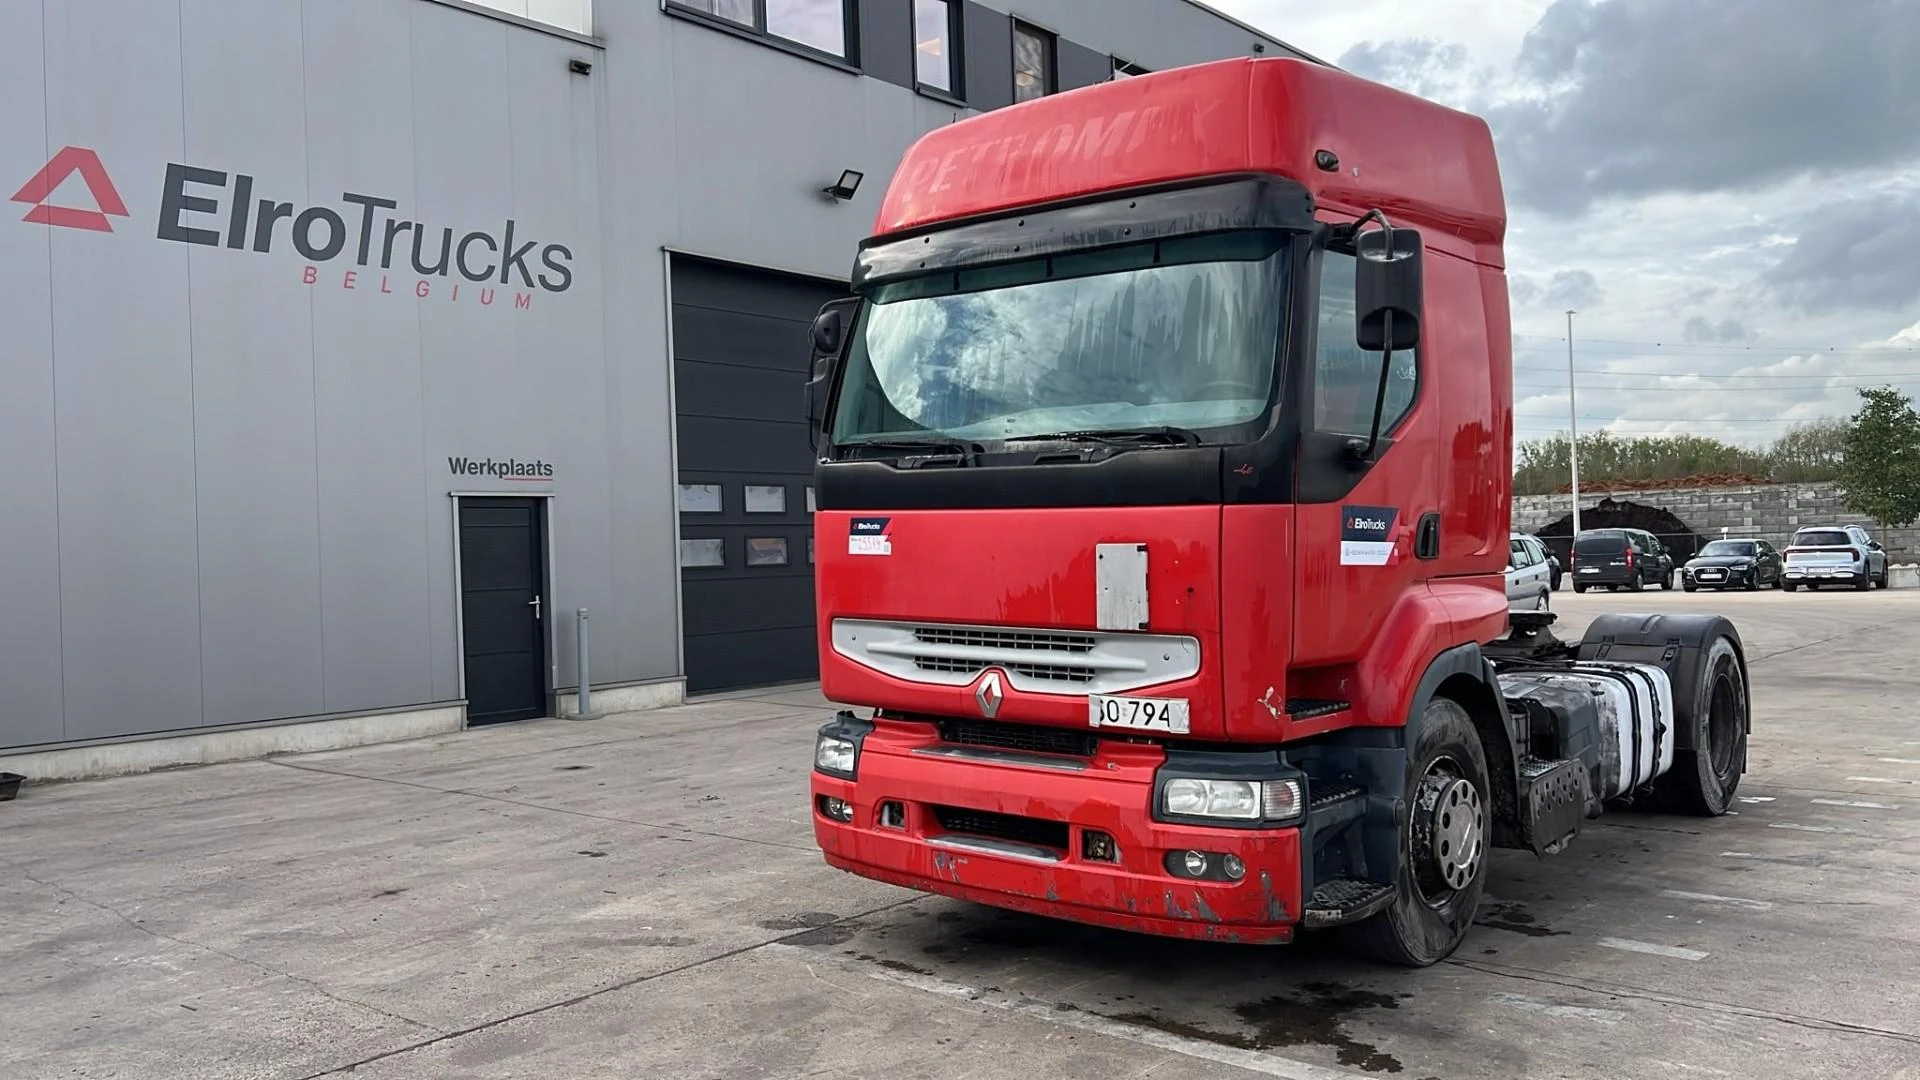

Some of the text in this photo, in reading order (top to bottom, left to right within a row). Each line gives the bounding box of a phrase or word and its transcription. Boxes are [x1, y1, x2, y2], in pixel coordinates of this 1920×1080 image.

[156, 162, 573, 293] ElroTrucks
[303, 265, 532, 310] BELGIUM
[447, 456, 553, 479] Werkplaats
